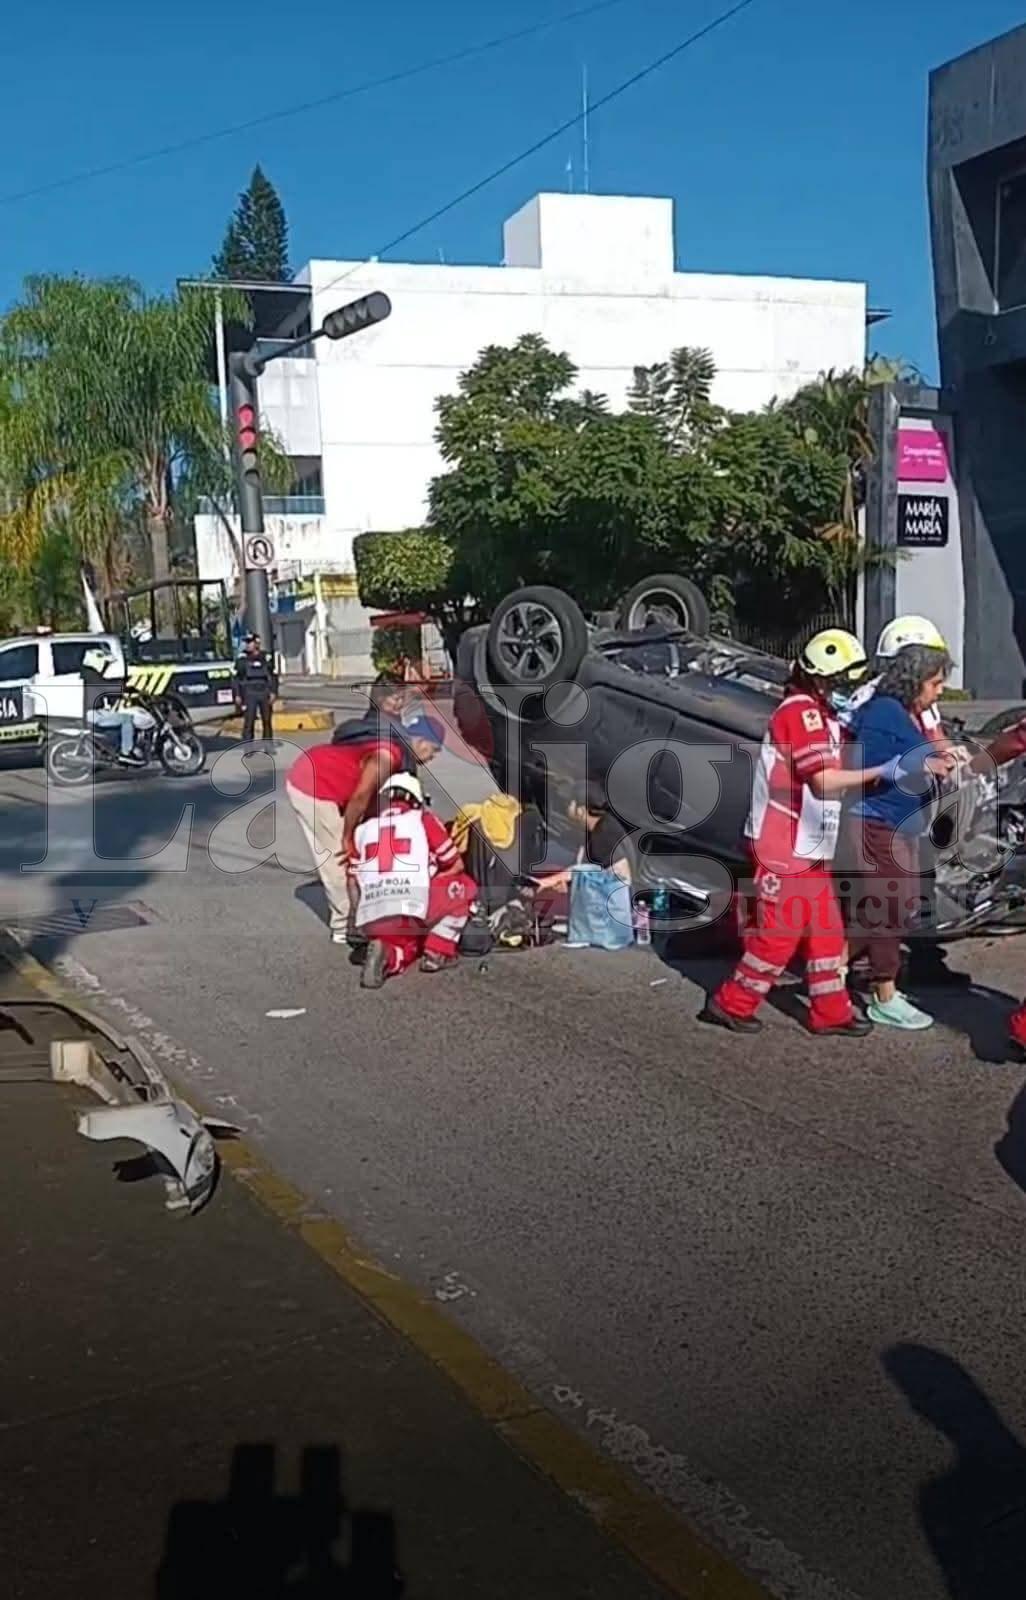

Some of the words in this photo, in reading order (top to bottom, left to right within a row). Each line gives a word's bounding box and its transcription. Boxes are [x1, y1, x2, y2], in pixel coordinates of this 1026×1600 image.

[904, 498, 943, 518] MARÍA
[904, 518, 942, 535] MARÍA
[385, 877, 411, 886] ROJA
[365, 887, 411, 900] MEXICANA
